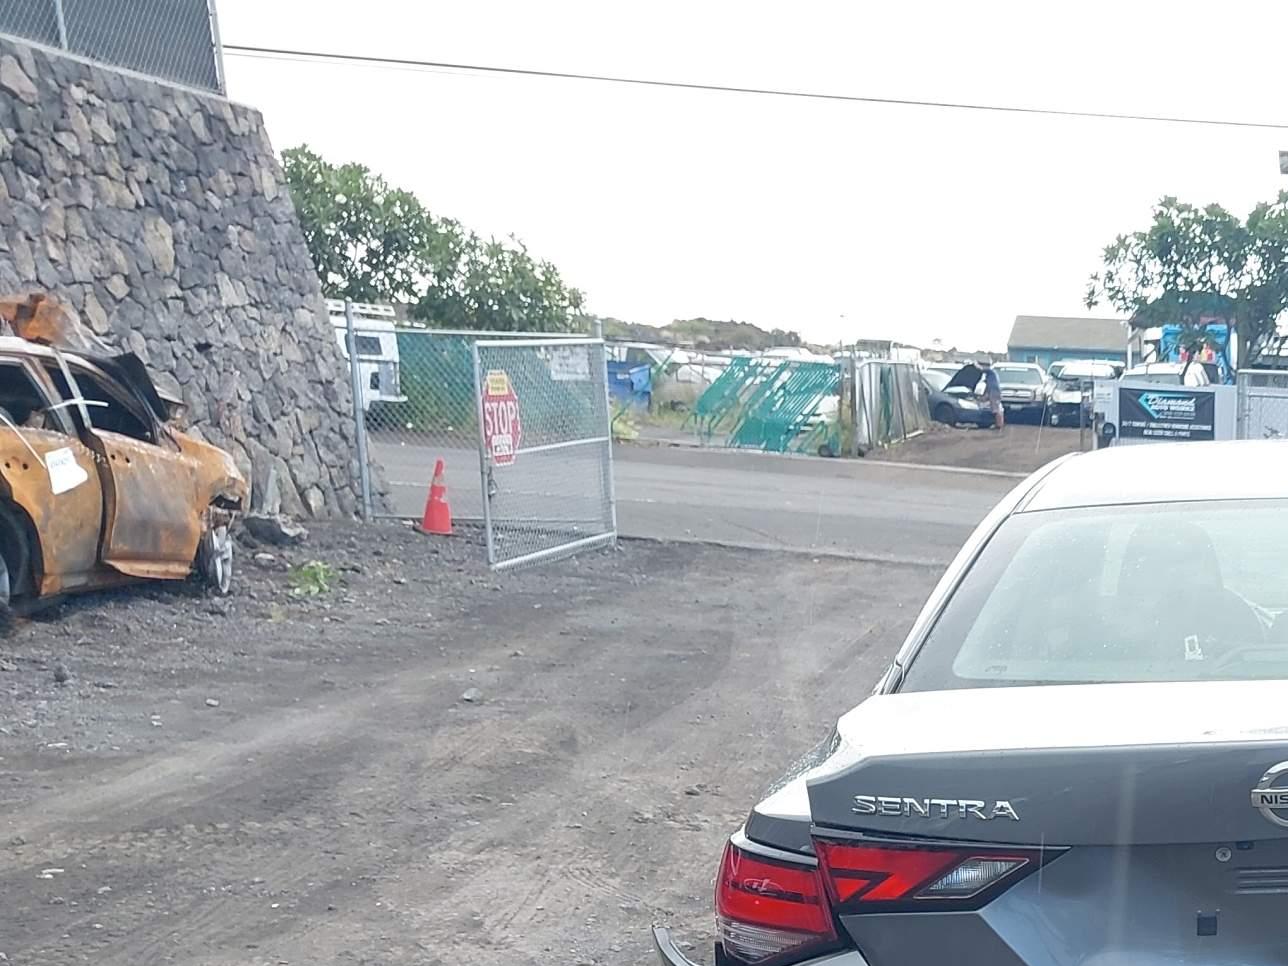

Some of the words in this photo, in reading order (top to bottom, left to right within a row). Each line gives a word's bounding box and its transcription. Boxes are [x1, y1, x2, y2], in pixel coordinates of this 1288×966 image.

[1147, 394, 1196, 406] Diamond
[484, 401, 516, 436] STOP
[851, 795, 1020, 821] SENTRA
